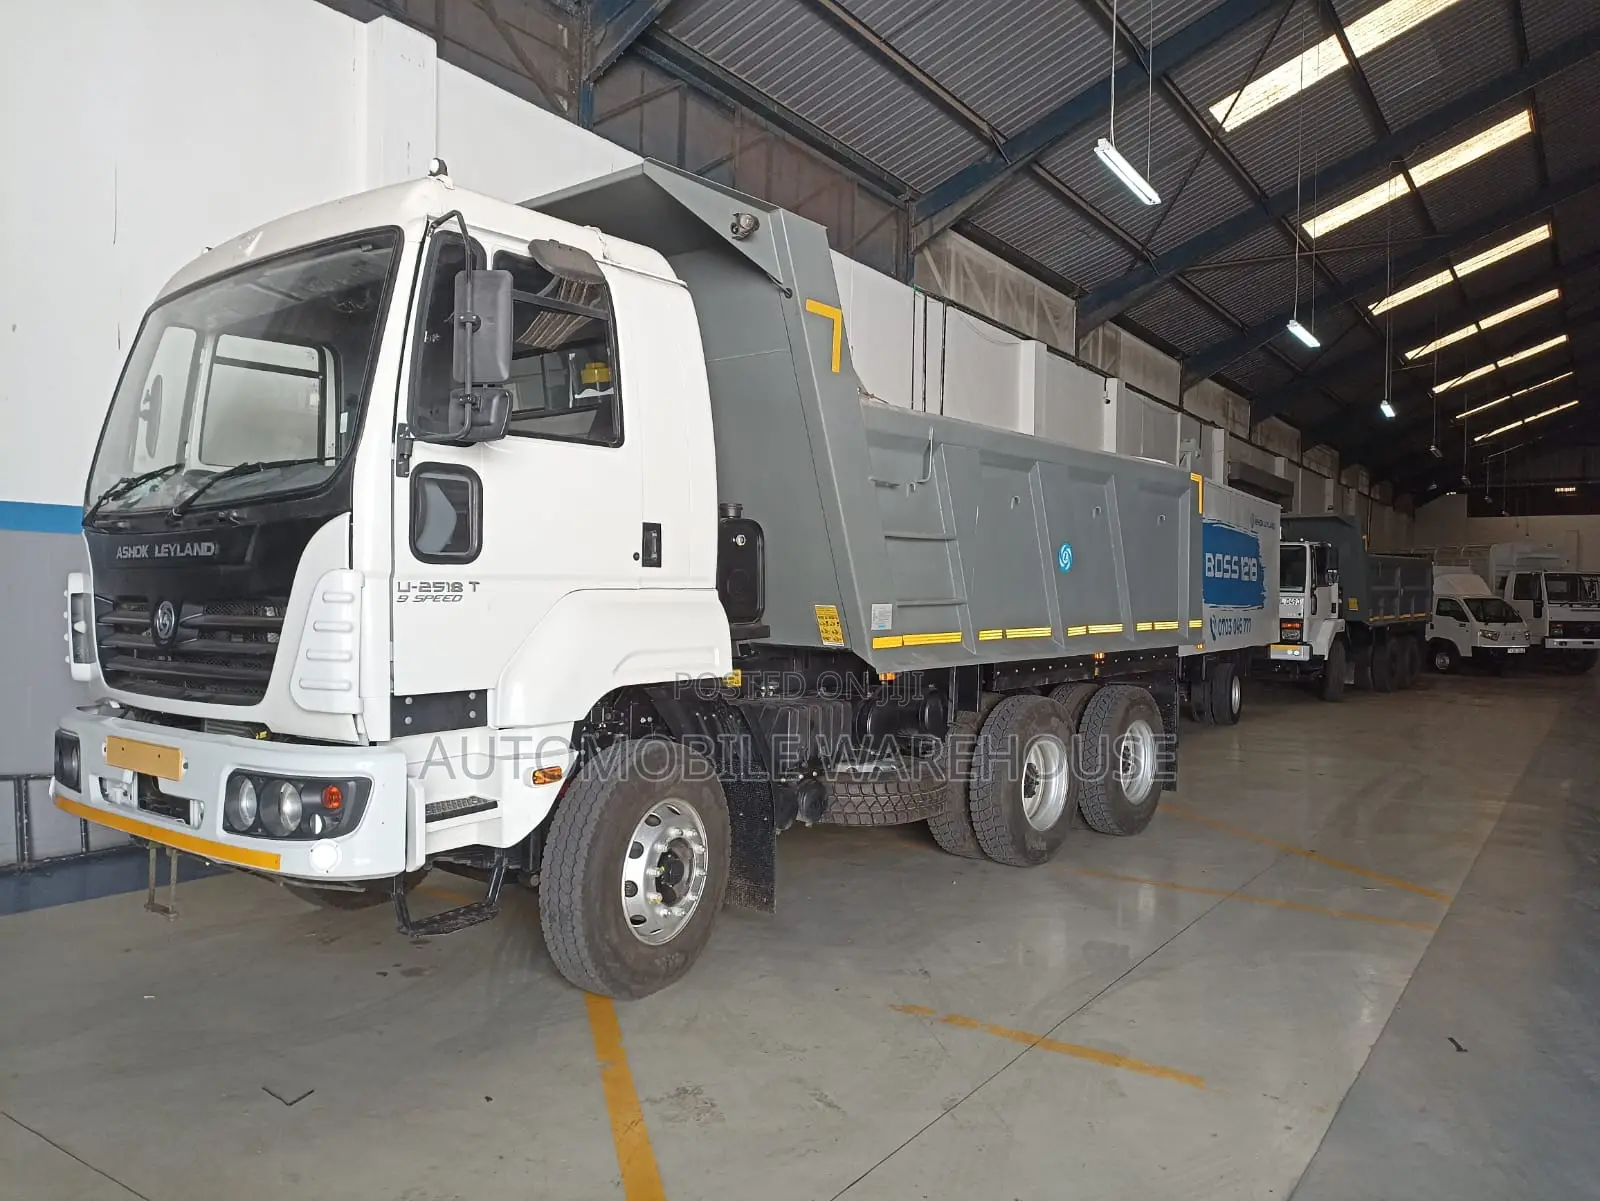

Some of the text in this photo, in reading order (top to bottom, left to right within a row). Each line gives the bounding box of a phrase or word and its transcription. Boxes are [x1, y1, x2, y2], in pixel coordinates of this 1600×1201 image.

[116, 542, 217, 559] ASHOK LEYLAND
[1205, 552, 1240, 579] BOSS
[397, 580, 480, 592] U-2518 T
[412, 594, 463, 602] SPEED
